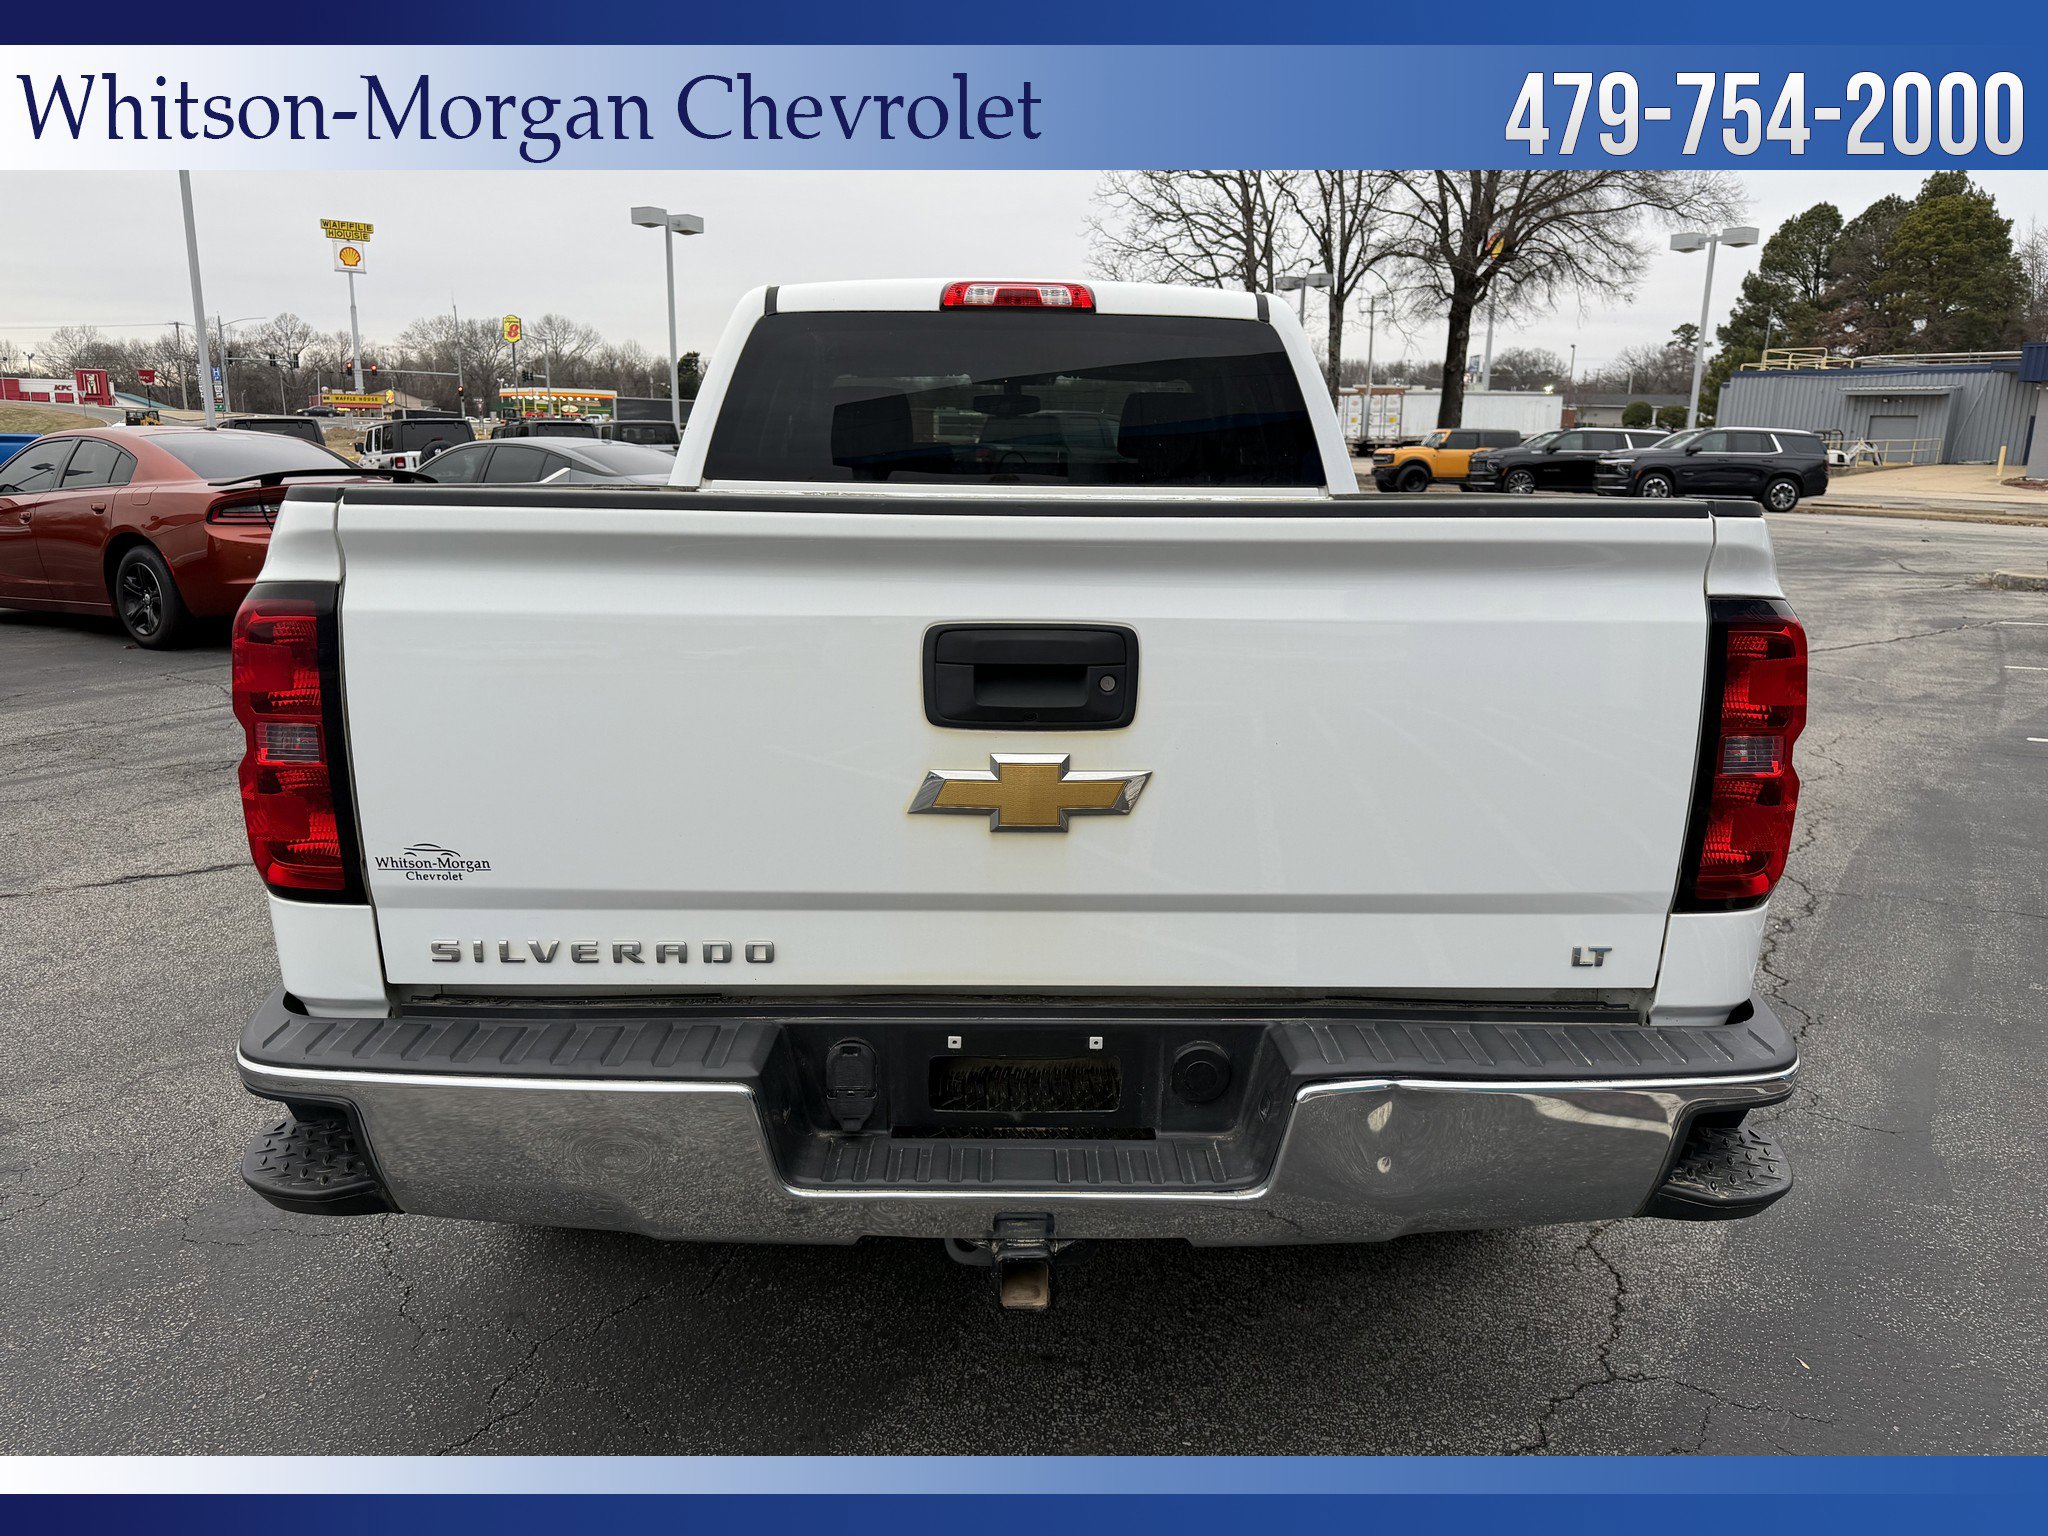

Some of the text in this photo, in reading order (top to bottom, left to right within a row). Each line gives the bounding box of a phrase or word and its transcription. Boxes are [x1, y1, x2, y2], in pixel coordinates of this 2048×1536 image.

[322, 220, 372, 232] WAFFLE
[328, 230, 369, 240] HOUSE
[507, 323, 519, 338] 8
[375, 857, 491, 873] Whitson-Morgan
[405, 871, 463, 881] Chevrolet
[430, 939, 777, 965] SILVERADO
[1571, 945, 1613, 967] LT
